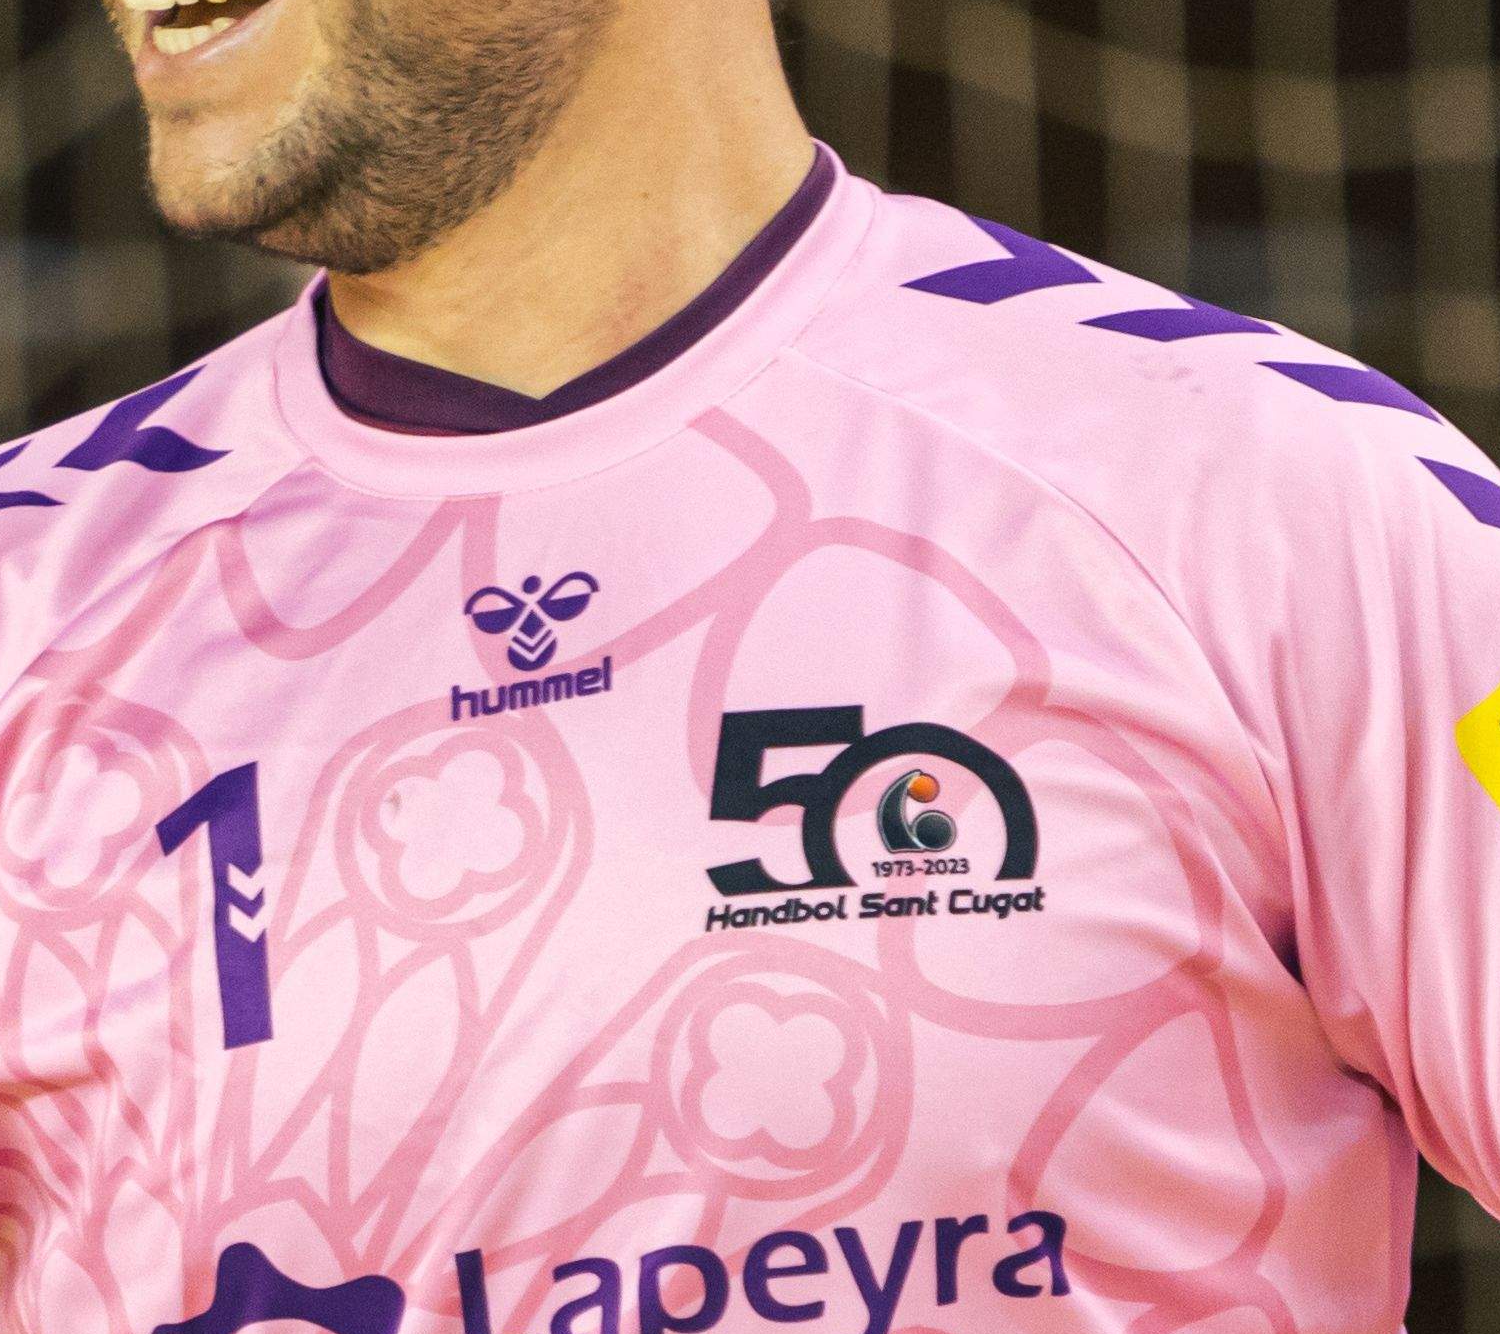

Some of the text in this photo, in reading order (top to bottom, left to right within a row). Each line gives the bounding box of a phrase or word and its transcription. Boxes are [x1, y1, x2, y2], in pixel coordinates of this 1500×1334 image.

[451, 655, 612, 722] hummel
[706, 705, 1038, 897] 50
[871, 857, 970, 878] 1973-2023
[155, 760, 274, 1050] 1
[704, 886, 1046, 932] Handbol Sant Cugat
